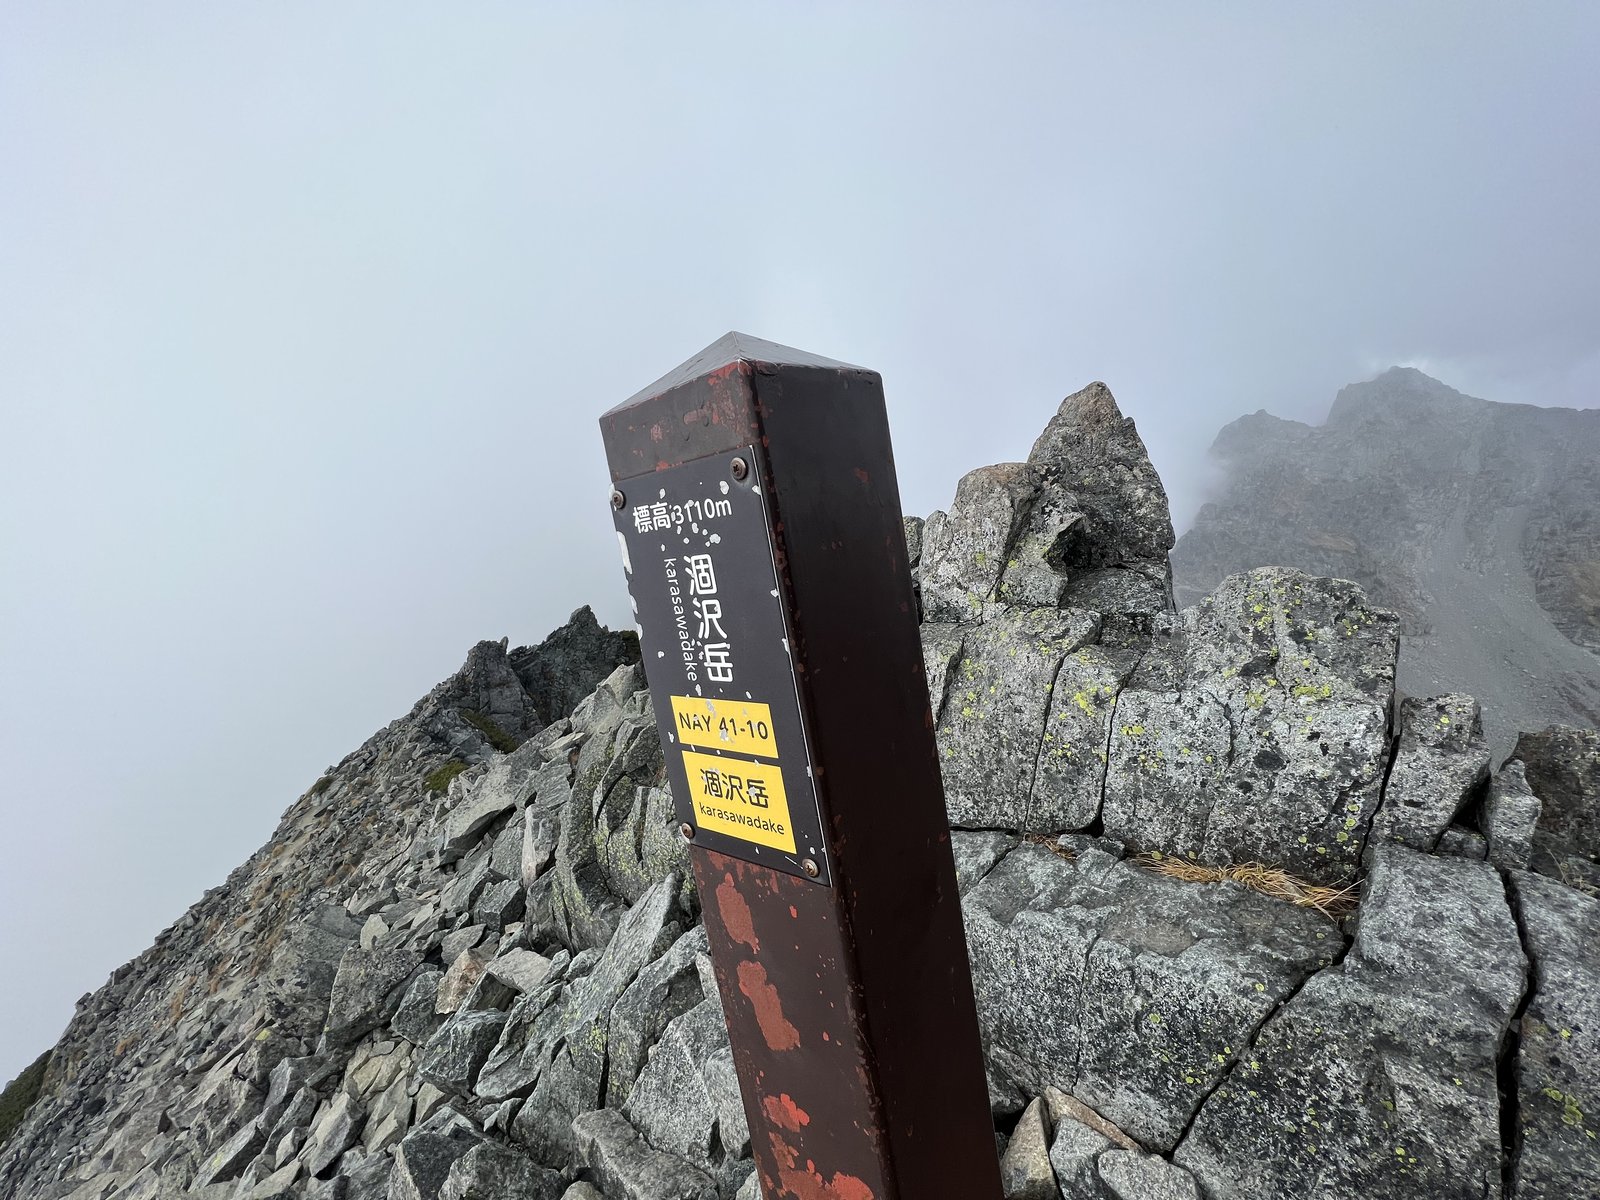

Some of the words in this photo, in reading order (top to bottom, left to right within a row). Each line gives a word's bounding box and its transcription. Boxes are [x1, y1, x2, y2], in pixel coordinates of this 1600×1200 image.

[663, 557, 699, 682] karasawadake
[683, 553, 734, 682] 涸沢岳
[679, 712, 711, 732] NAY
[719, 716, 769, 740] 41-10
[699, 768, 769, 809] 涸沢岳
[698, 802, 785, 835] karasawadake
